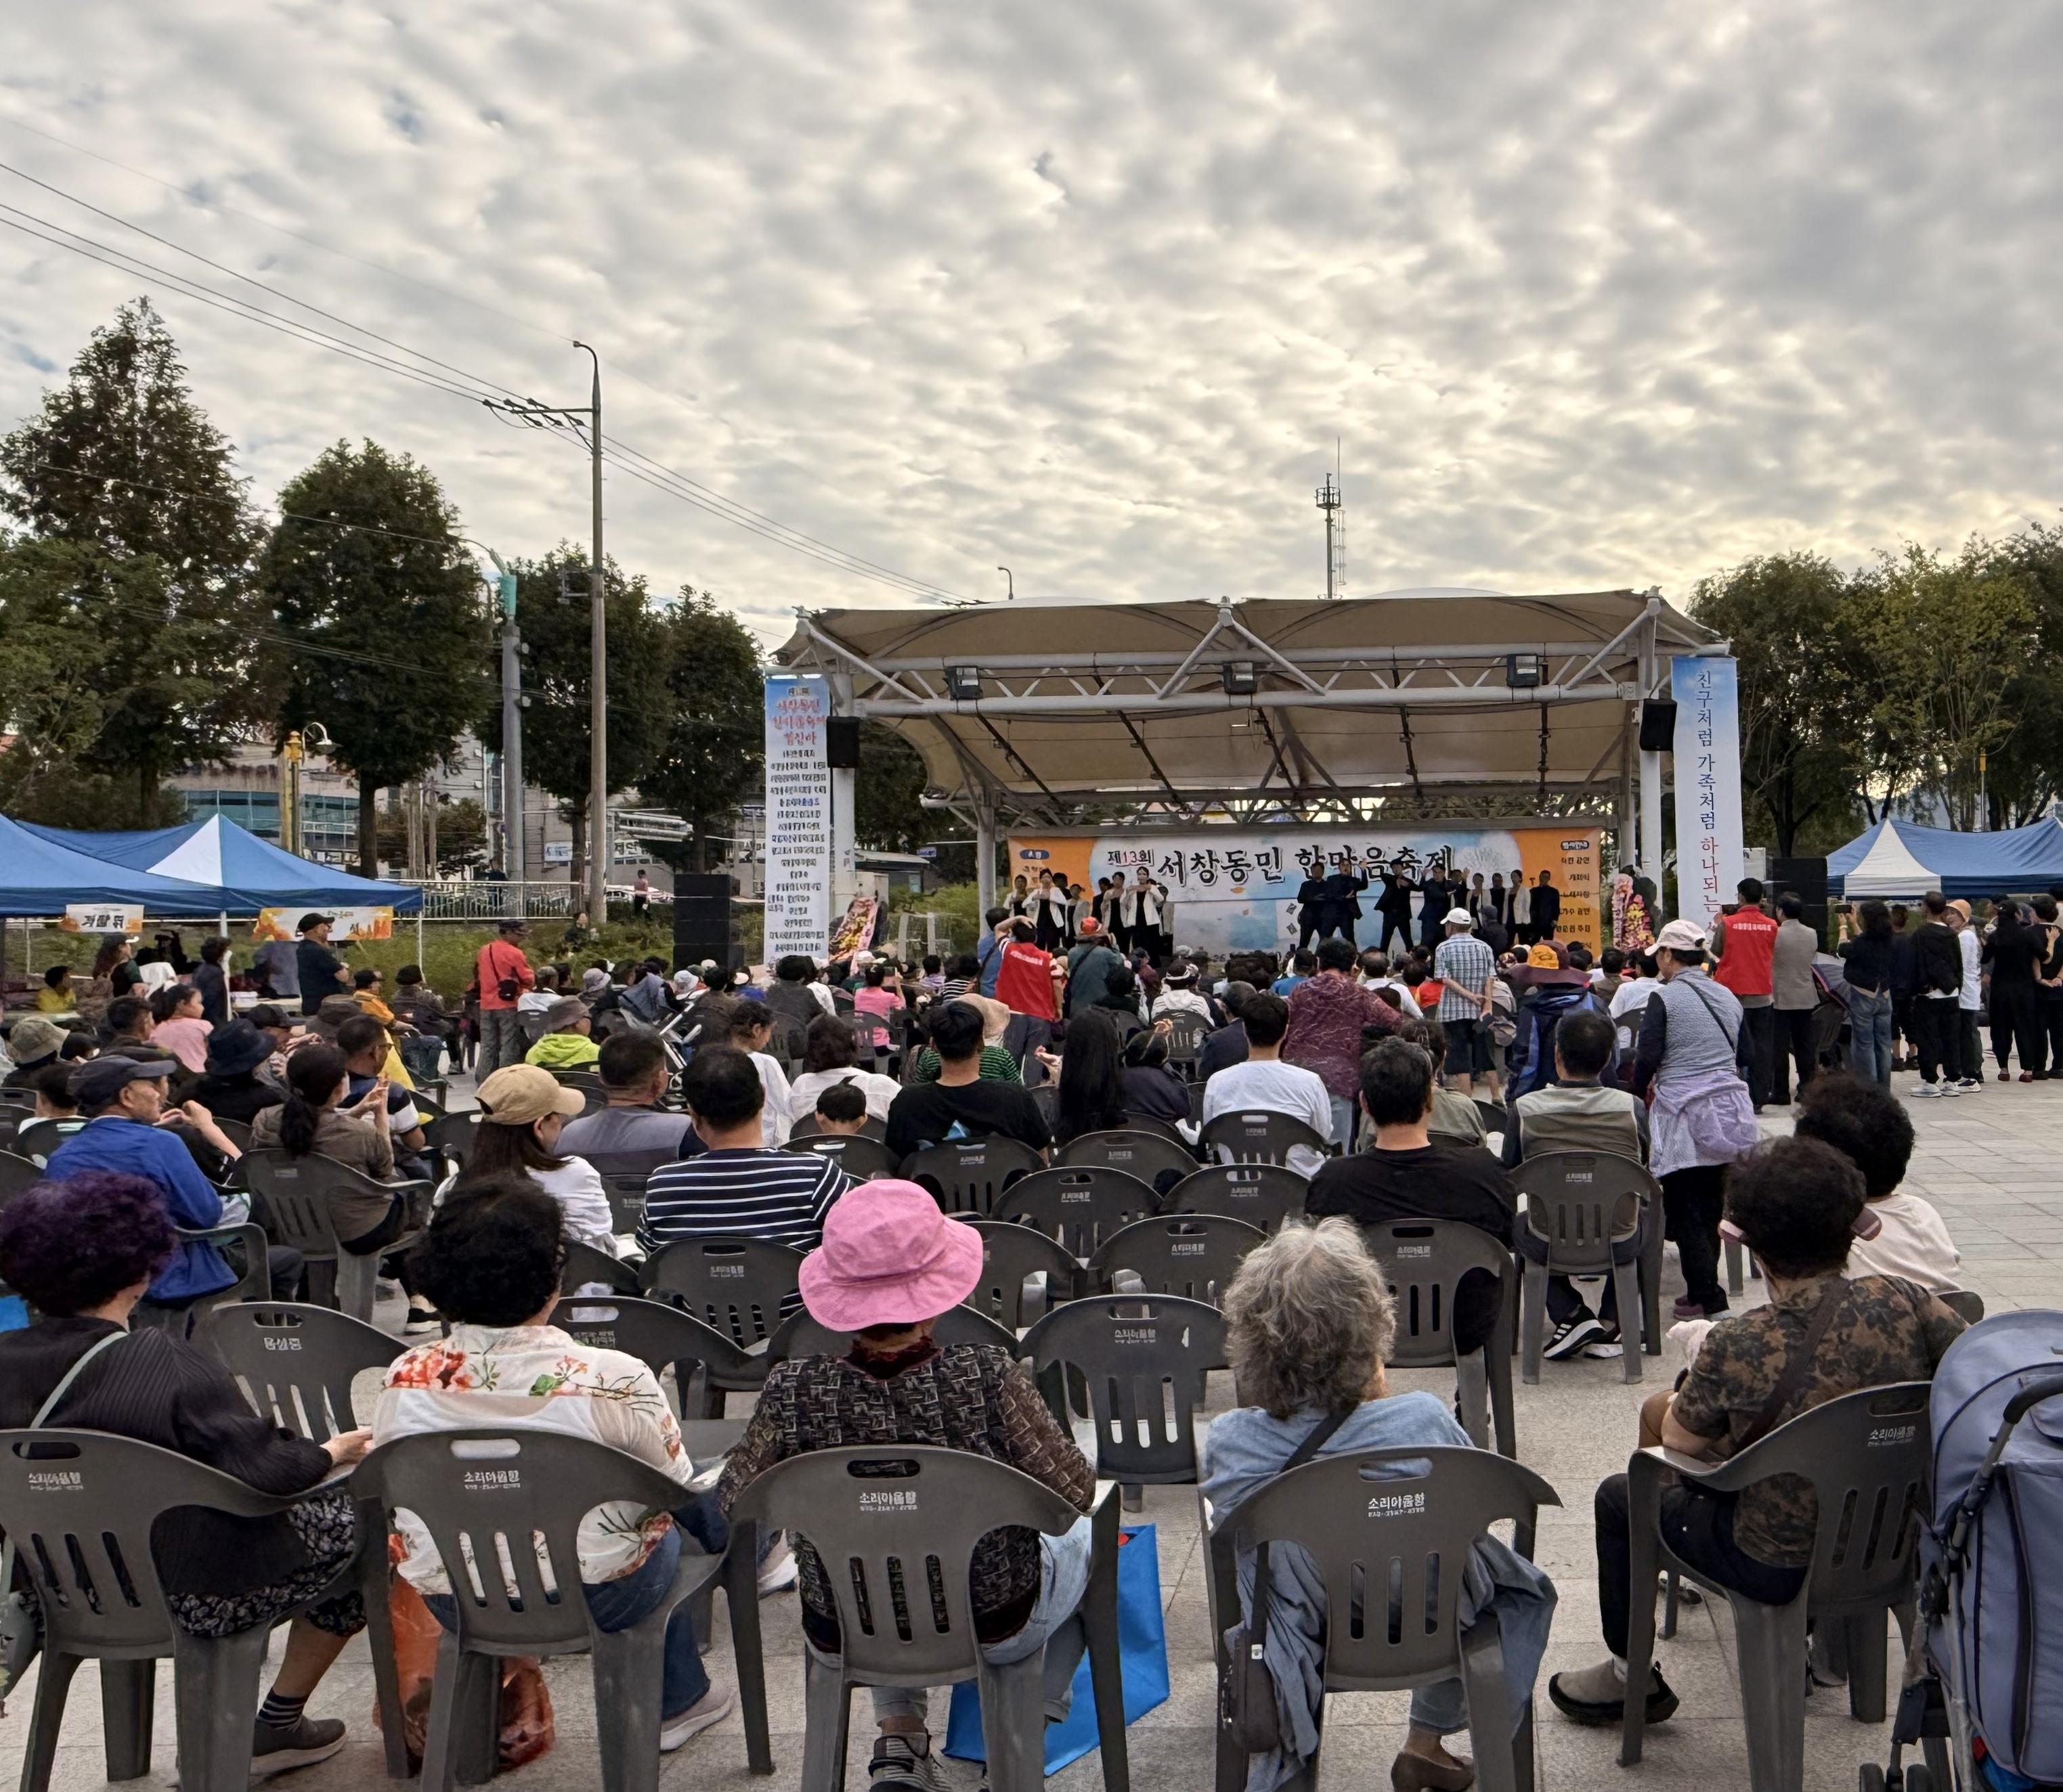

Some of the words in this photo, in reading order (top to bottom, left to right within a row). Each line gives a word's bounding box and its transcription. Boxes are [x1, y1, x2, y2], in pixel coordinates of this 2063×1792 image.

[1696, 670, 1713, 747] 친구처럼
[1697, 753, 1716, 830] 가족처럼
[1108, 849, 1153, 865] 제13회
[1157, 846, 1284, 884] 서창동민
[1295, 844, 1452, 882] 한마음축제
[1700, 836, 1721, 913] 하나되는
